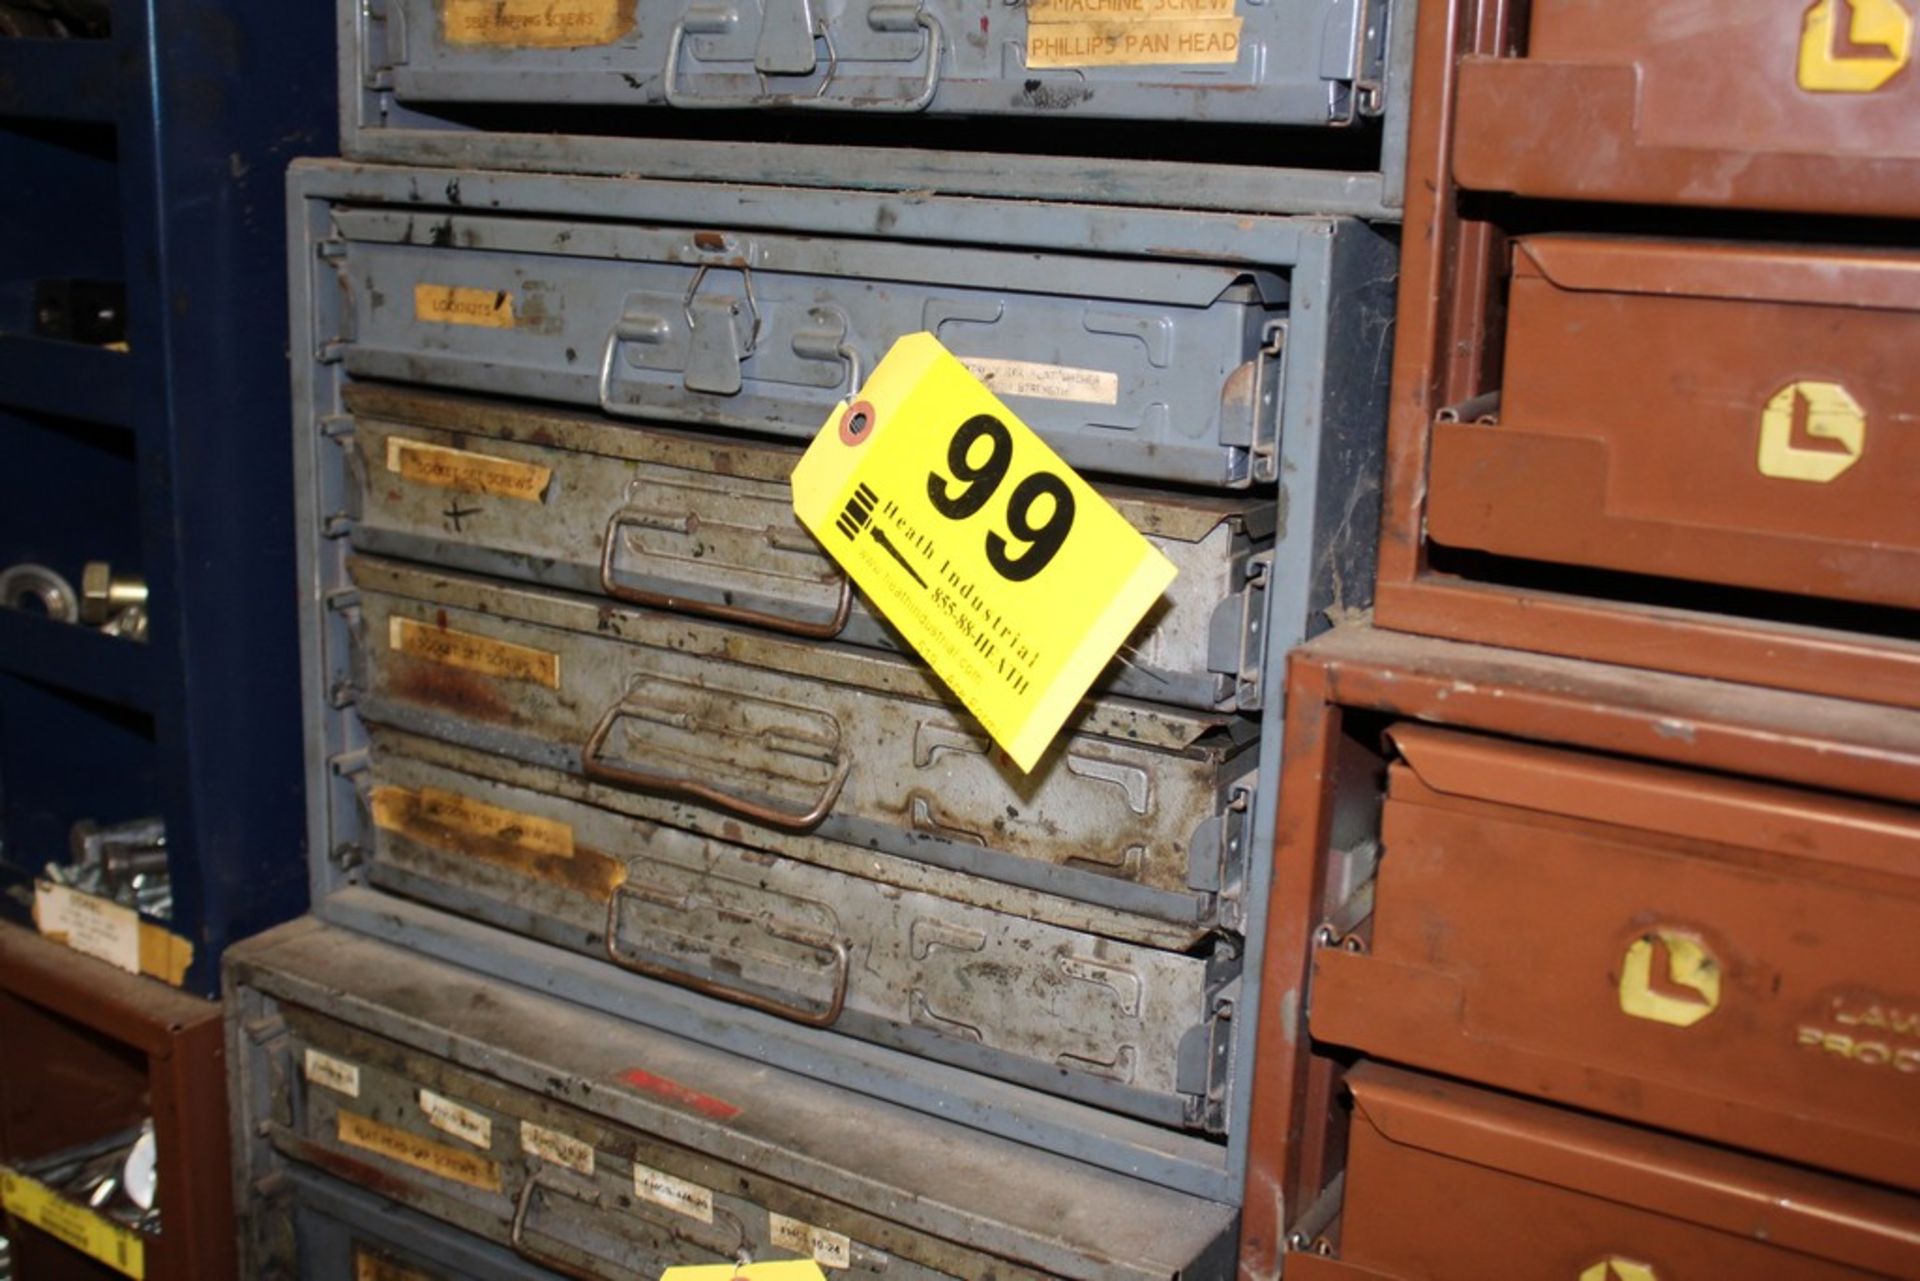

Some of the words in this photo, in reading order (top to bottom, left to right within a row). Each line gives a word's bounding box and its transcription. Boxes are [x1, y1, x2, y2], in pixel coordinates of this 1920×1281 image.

[1031, 36, 1116, 56] PHILLIPS
[1124, 34, 1169, 53] PAN
[1178, 32, 1239, 52] HEAD
[926, 413, 1077, 583] 99
[881, 499, 939, 560] Heath
[938, 559, 1042, 669] Industrial
[928, 587, 1031, 696] 855-88-HEATH
